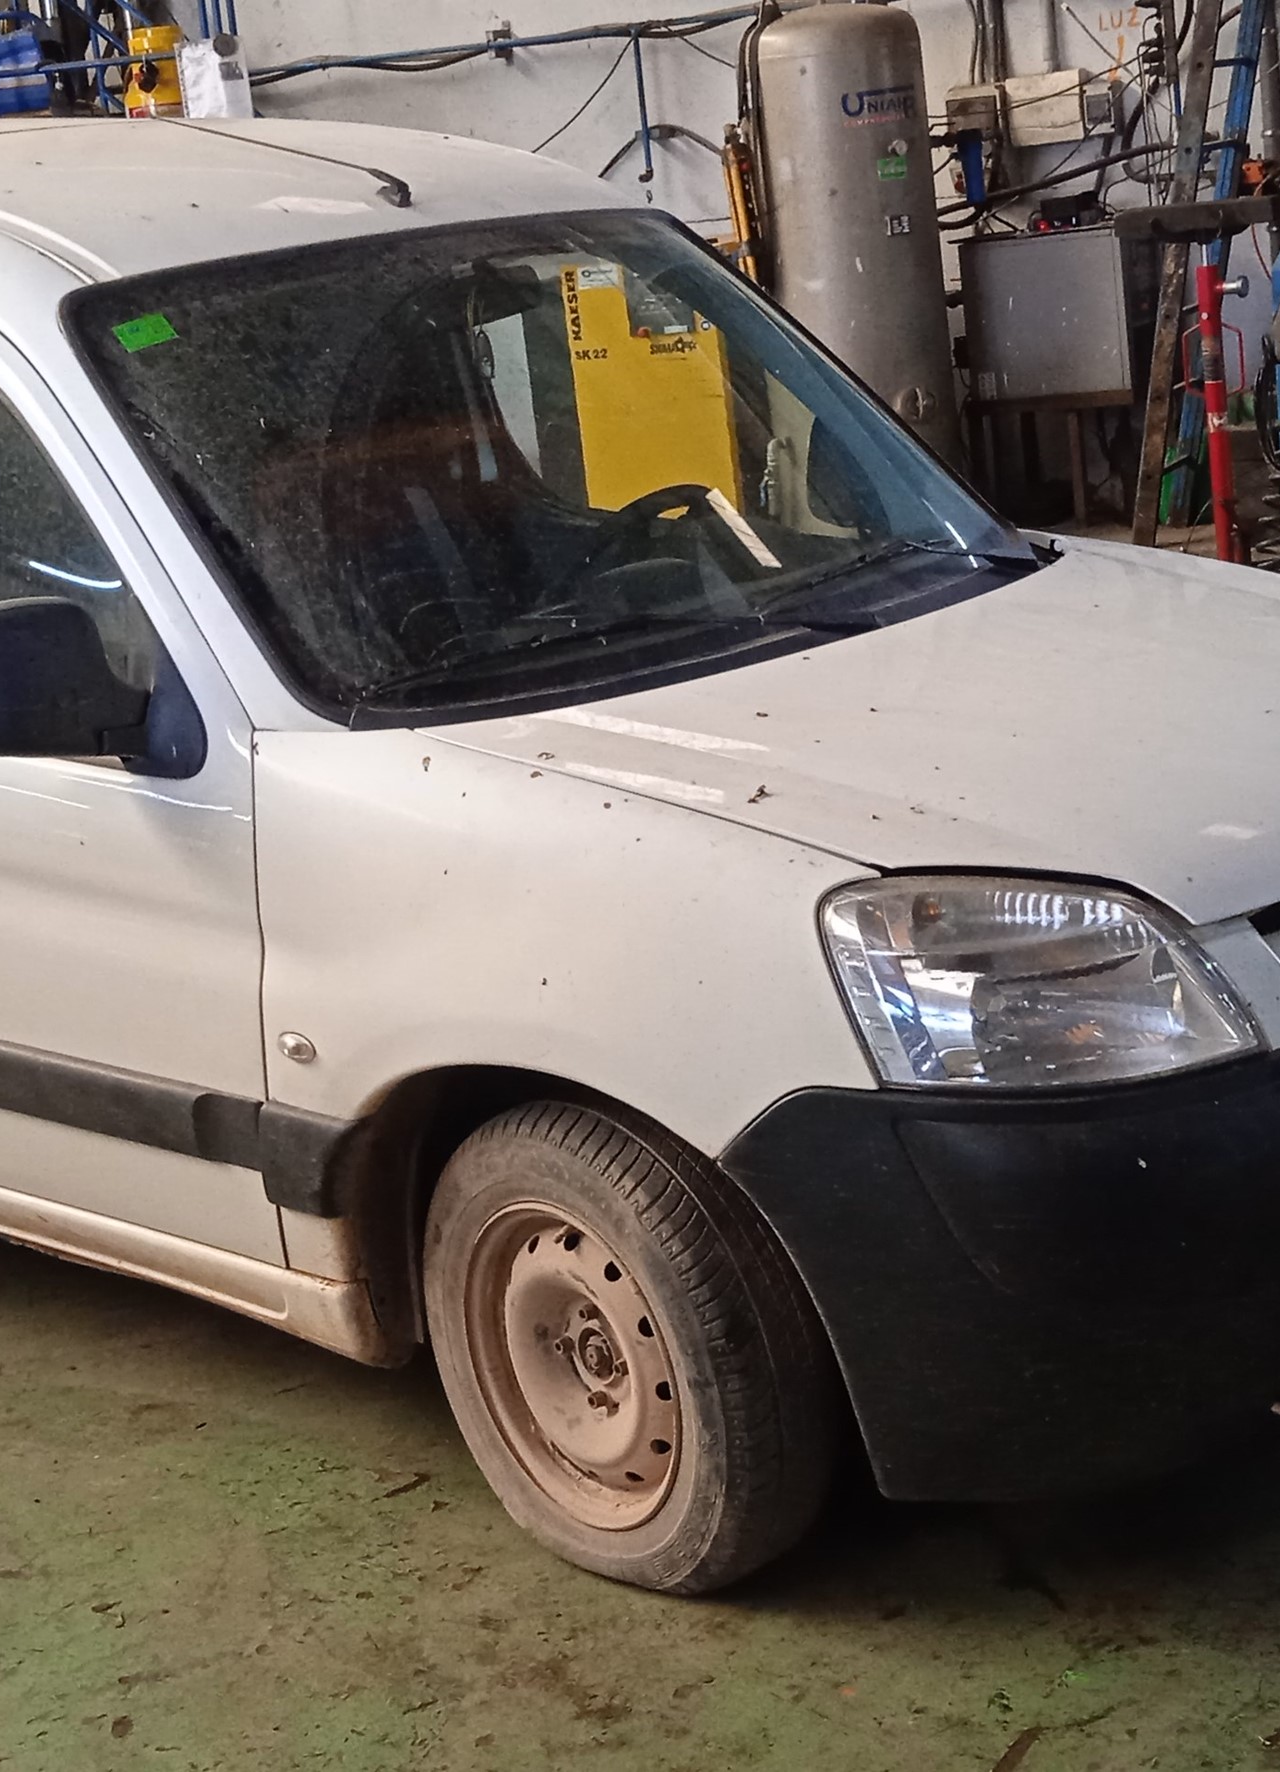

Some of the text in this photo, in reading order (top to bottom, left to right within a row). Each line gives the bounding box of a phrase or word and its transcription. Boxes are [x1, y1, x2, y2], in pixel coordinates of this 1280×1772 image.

[1098, 7, 1141, 32] LUZ
[564, 271, 582, 341] KAESER
[575, 348, 608, 361] SK 22
